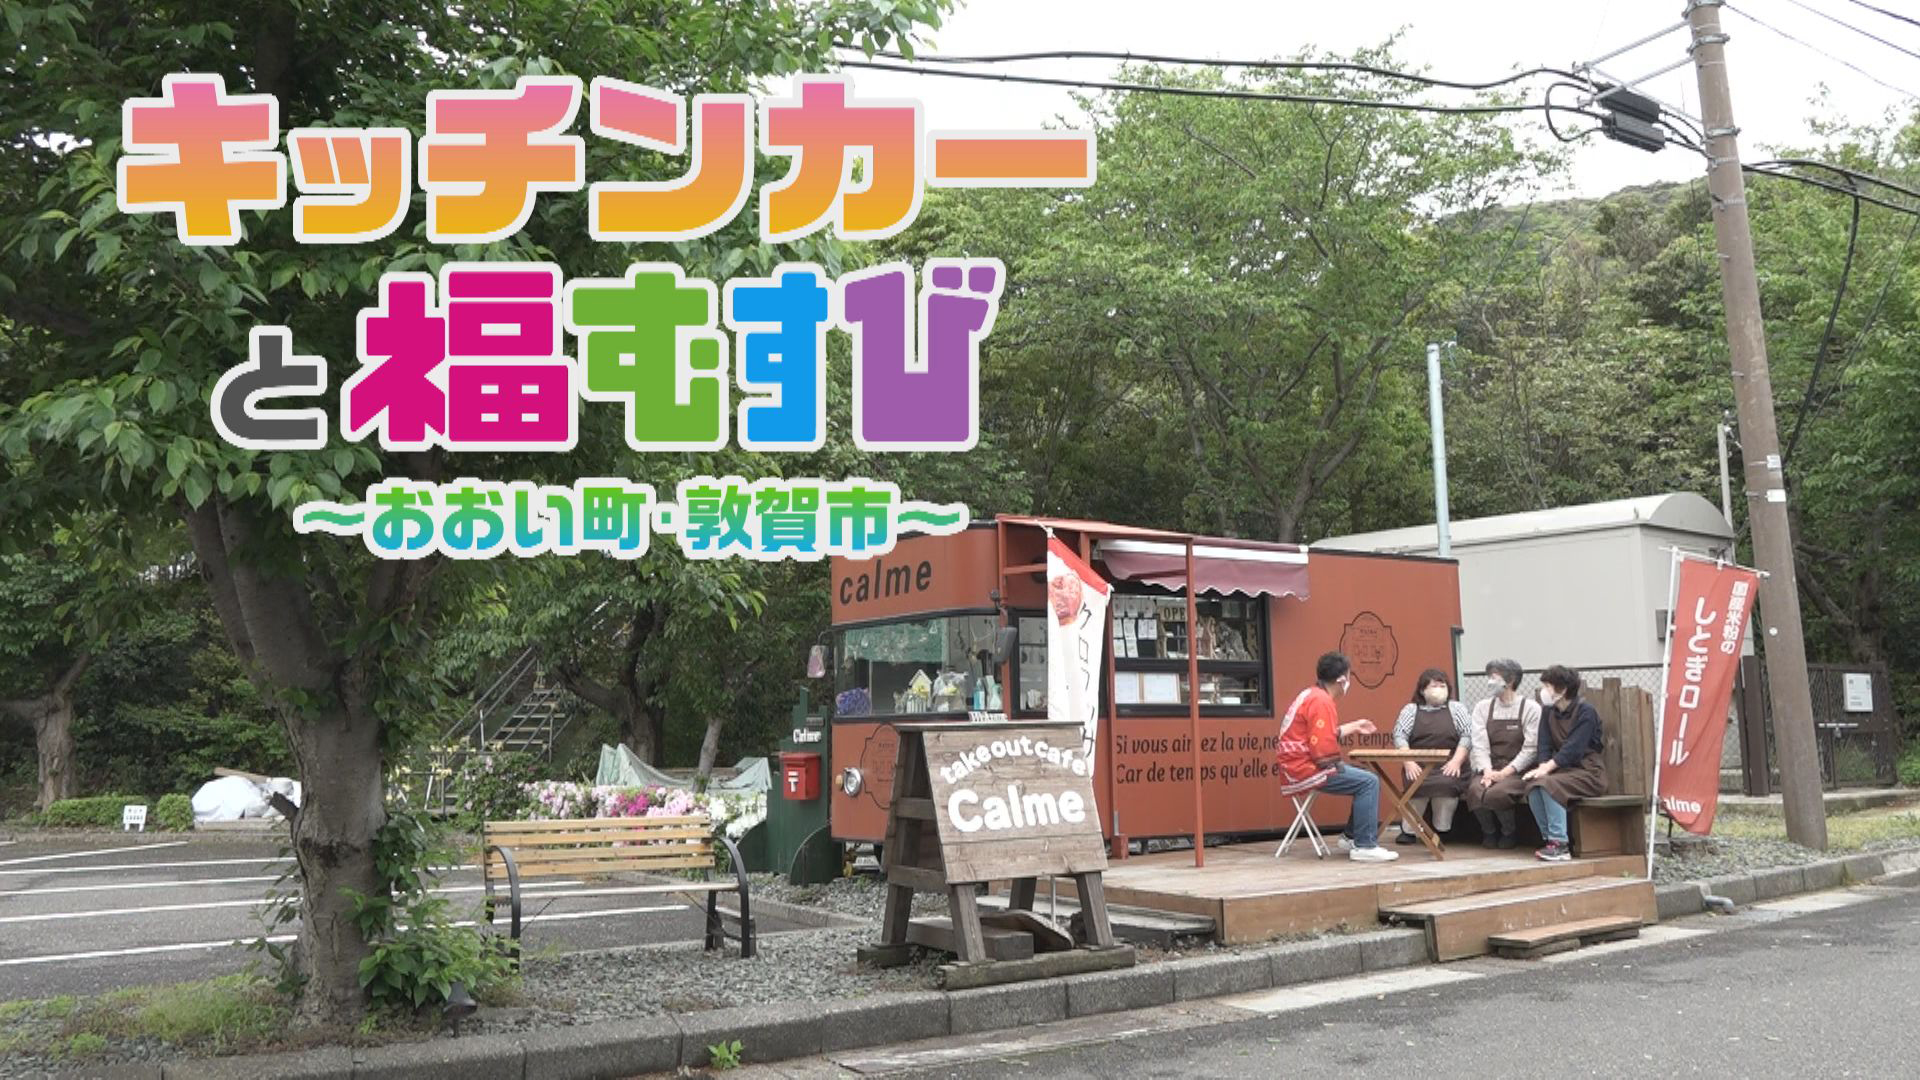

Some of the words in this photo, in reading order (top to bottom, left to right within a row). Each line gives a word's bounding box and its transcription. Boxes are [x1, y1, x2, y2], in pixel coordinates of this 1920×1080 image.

[840, 559, 932, 604] calme
[1164, 607, 1188, 620] OPE
[1669, 596, 1717, 766] しとぎロール
[793, 728, 821, 743] Calme
[1132, 738, 1168, 754] vous
[1221, 731, 1234, 752] la
[1116, 763, 1143, 784] Car
[1146, 761, 1166, 783] de
[947, 784, 1086, 833] Calme
[1663, 796, 1702, 817] alme
